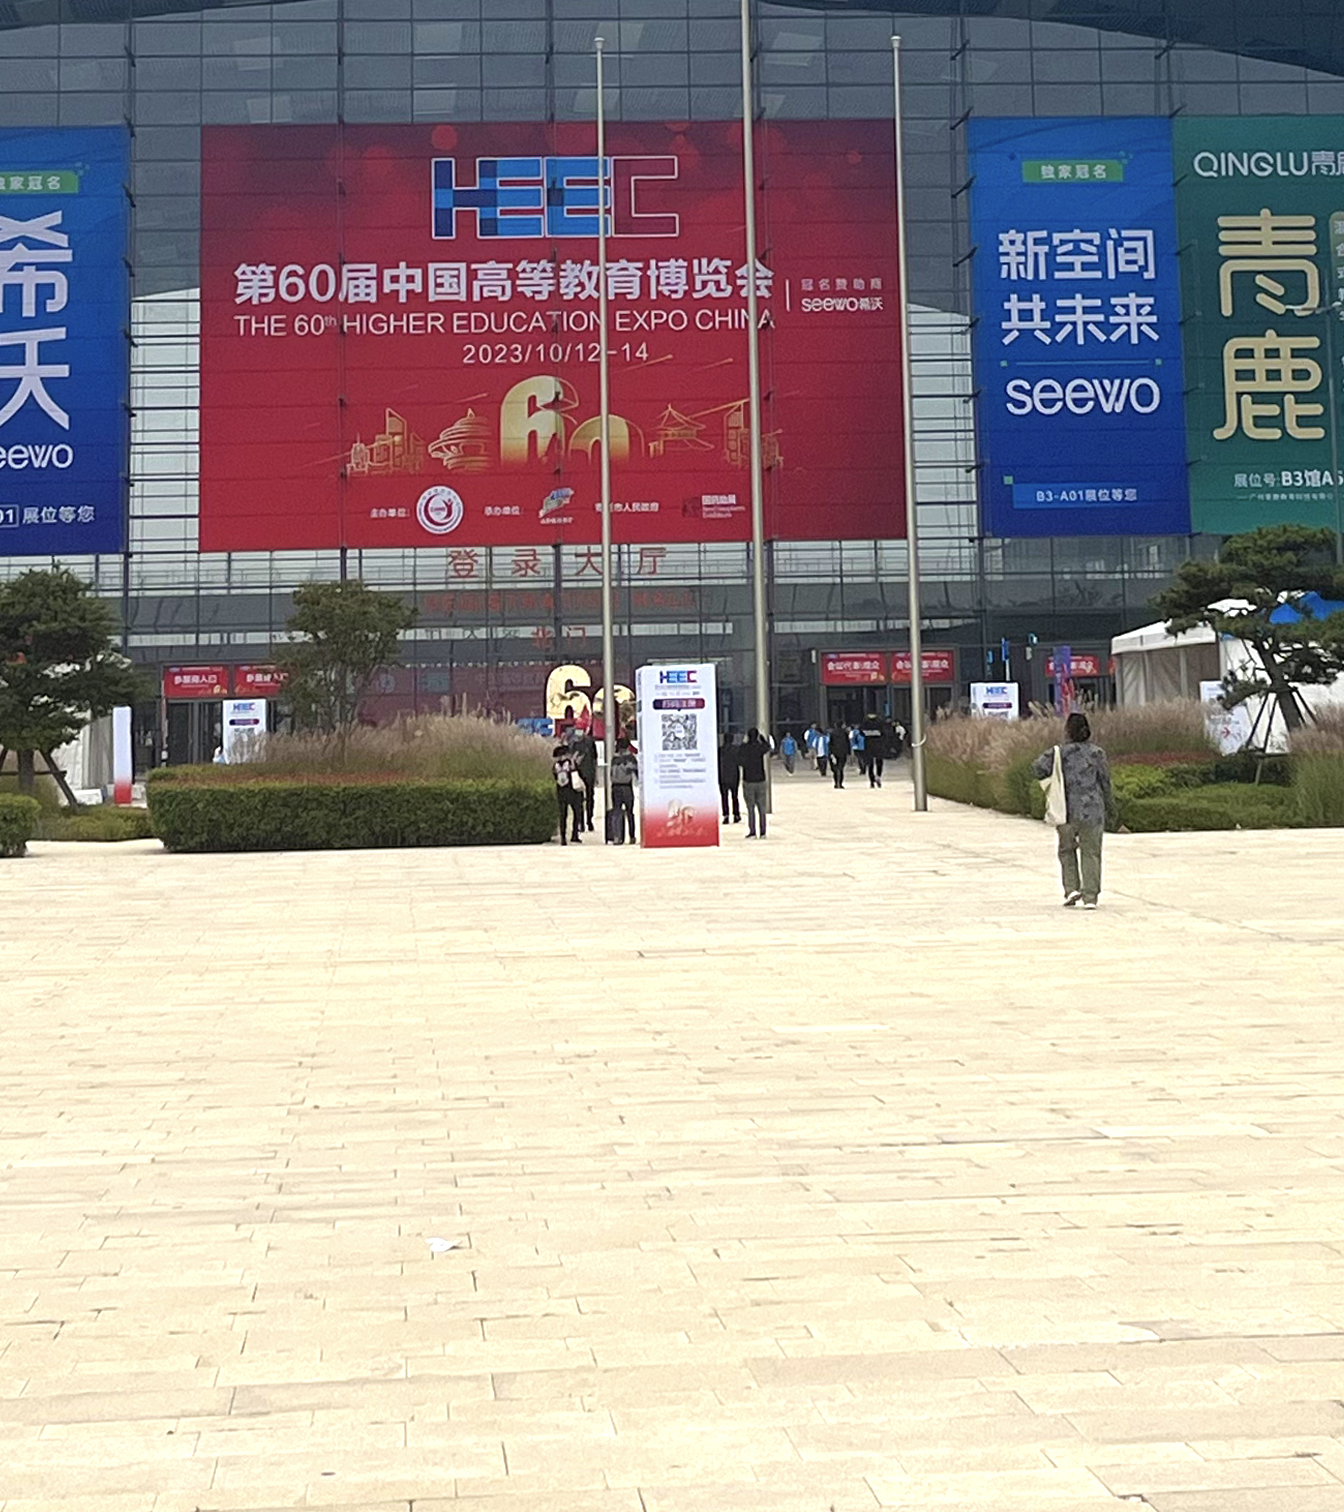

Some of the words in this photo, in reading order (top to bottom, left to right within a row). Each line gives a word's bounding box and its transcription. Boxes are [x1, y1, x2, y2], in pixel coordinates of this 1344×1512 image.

[431, 156, 679, 239] HEEC
[998, 228, 1156, 281] 新空间
[233, 258, 774, 304] 第60届中国高等教育博览会
[233, 315, 287, 336] THE
[342, 312, 445, 335] HIGHER
[452, 311, 602, 334] EDUCATION
[615, 309, 689, 332] EXPO
[695, 308, 775, 331] CHINA
[1001, 292, 1159, 345] 共未来
[1213, 208, 1325, 440] 青鹿
[462, 342, 649, 364] 2023/10/12-14
[1005, 377, 1160, 415] seewo
[22, 505, 95, 524] 展位等您
[595, 502, 659, 512] 青市人民政府
[447, 546, 667, 579] 登录大厅
[660, 671, 697, 684] HEEC
